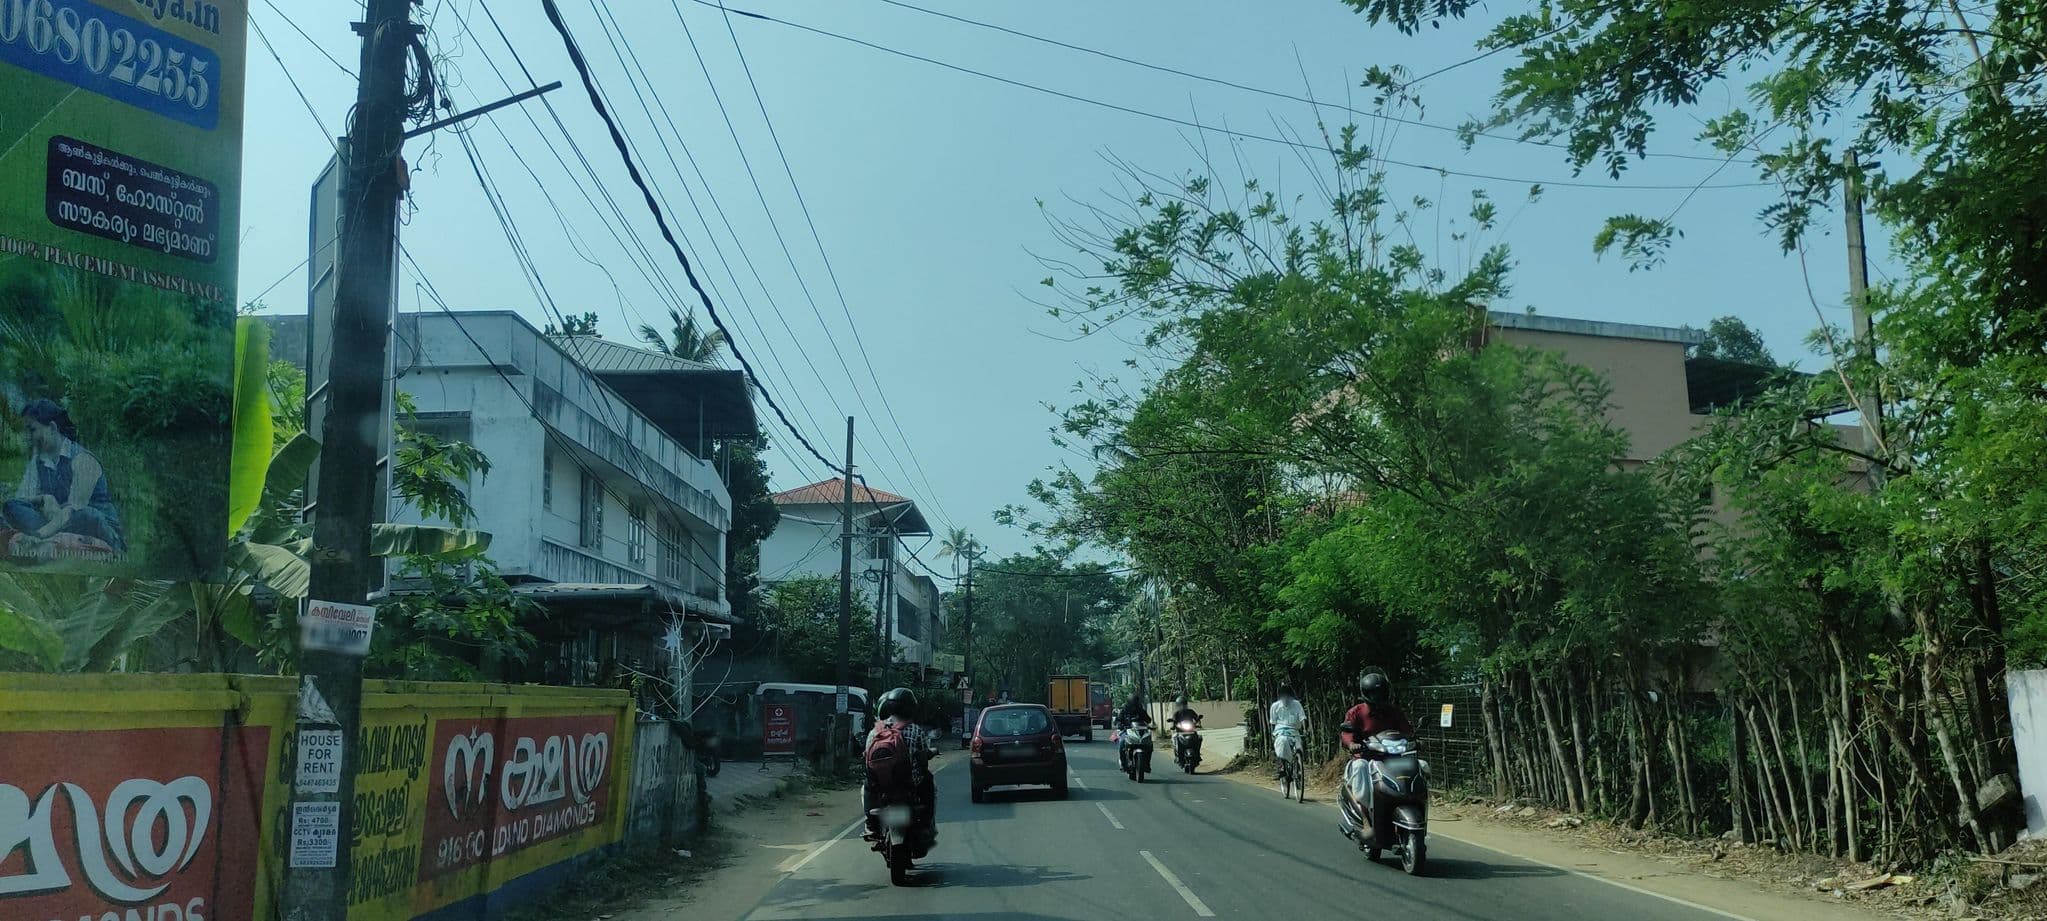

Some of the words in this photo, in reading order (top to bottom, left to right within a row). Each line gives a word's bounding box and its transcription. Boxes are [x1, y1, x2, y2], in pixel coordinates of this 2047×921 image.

[62, 168, 110, 202] ബസ്,
[116, 184, 204, 229] ഹോസ്റ്റൽ
[44, 246, 138, 282] PLACEMENT
[301, 735, 340, 746] HOUSE
[308, 748, 332, 760] FOR
[304, 762, 334, 773] RENT
[437, 837, 463, 866] 916
[533, 802, 597, 840] DIAMONDS
